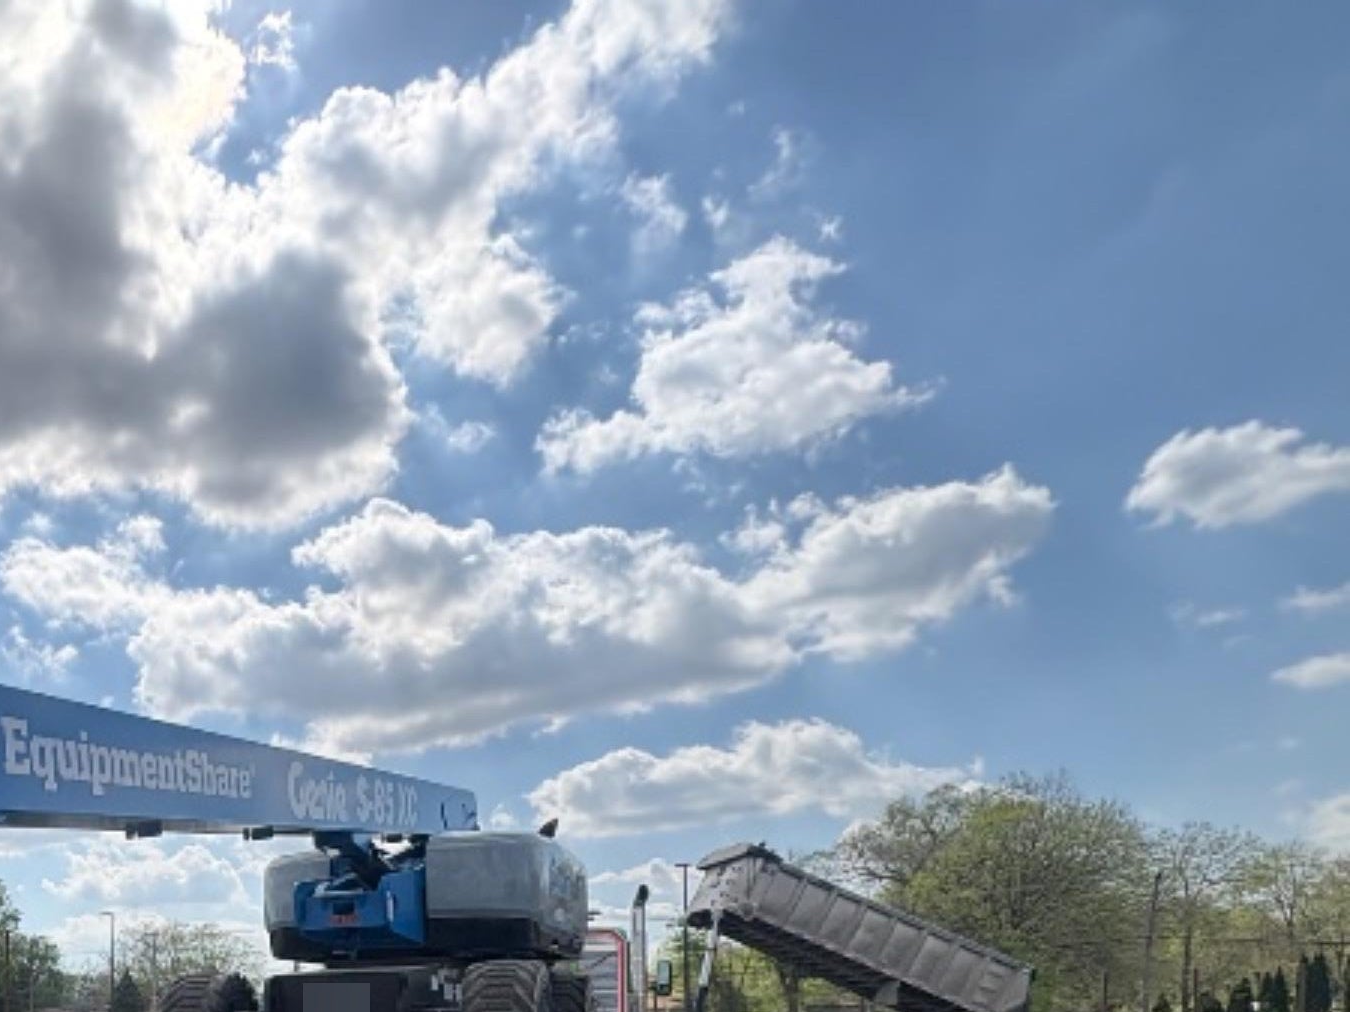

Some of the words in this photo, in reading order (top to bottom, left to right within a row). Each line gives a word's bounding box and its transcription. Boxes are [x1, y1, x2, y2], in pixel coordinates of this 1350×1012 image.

[1, 716, 253, 798] EquipmentShare
[287, 761, 348, 822] Genie
[356, 773, 395, 827] S-85
